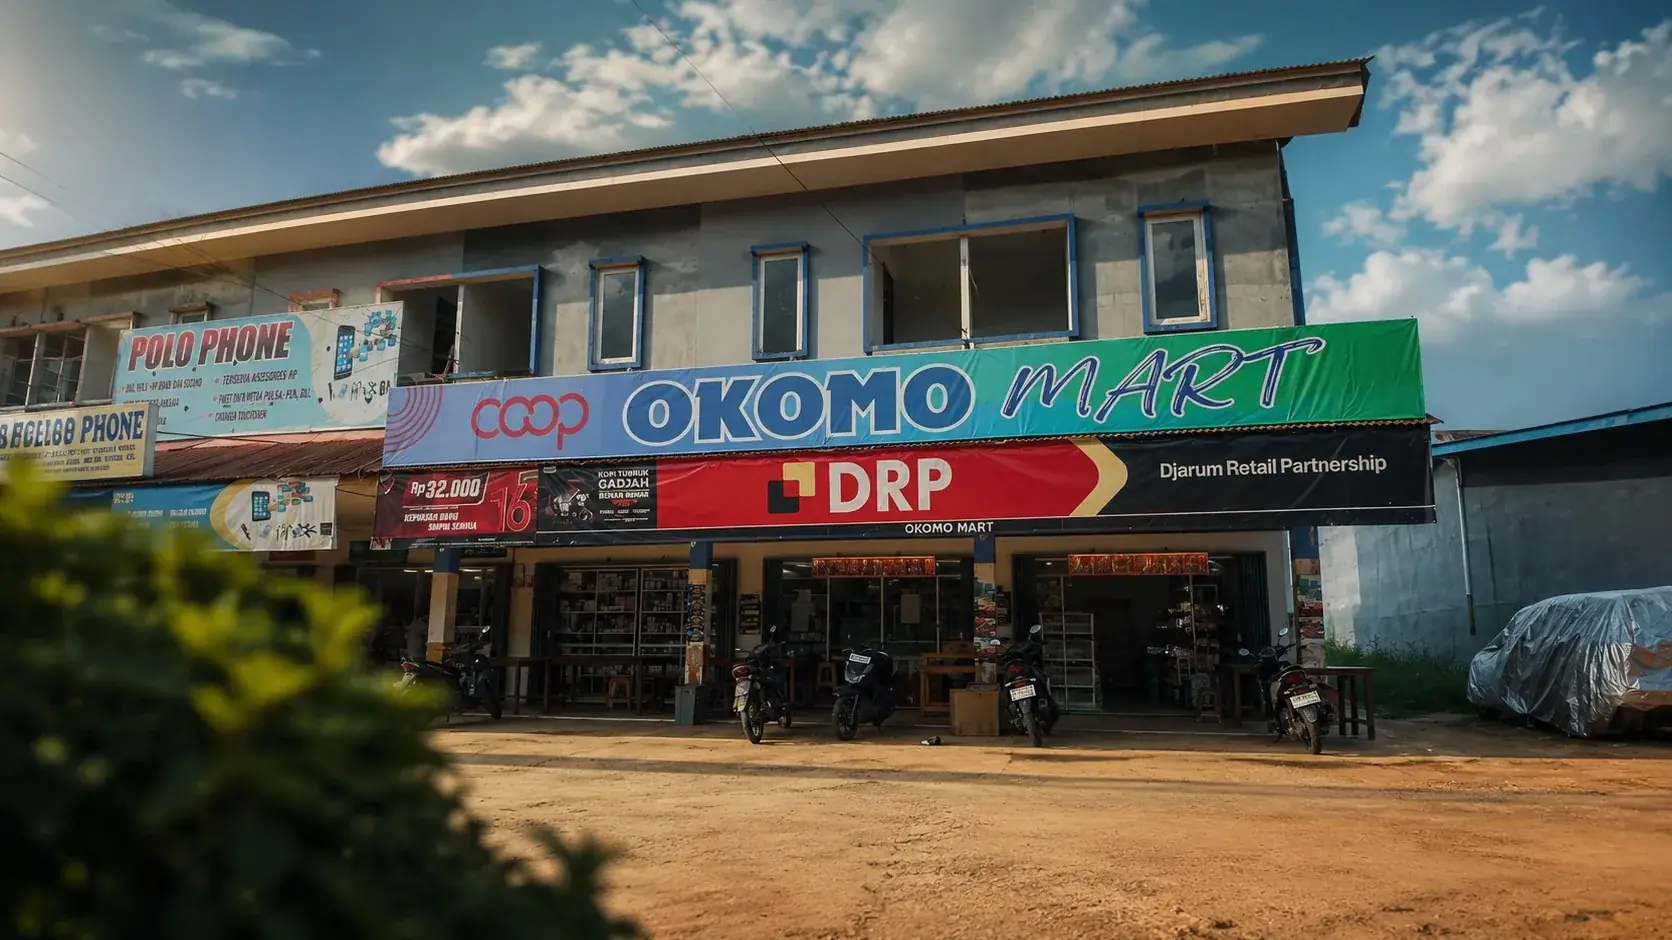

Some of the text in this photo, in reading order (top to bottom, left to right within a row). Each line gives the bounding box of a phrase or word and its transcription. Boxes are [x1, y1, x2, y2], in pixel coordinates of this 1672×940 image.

[127, 320, 294, 372] POLO PHONE
[471, 337, 1326, 450] coop OKOMO MART
[80, 410, 145, 443] PHONE
[598, 478, 649, 489] GADJAH
[1160, 455, 1388, 480] Djarum Retail Partnership
[829, 458, 953, 514] DRP
[905, 521, 994, 534] OKOMO MART
